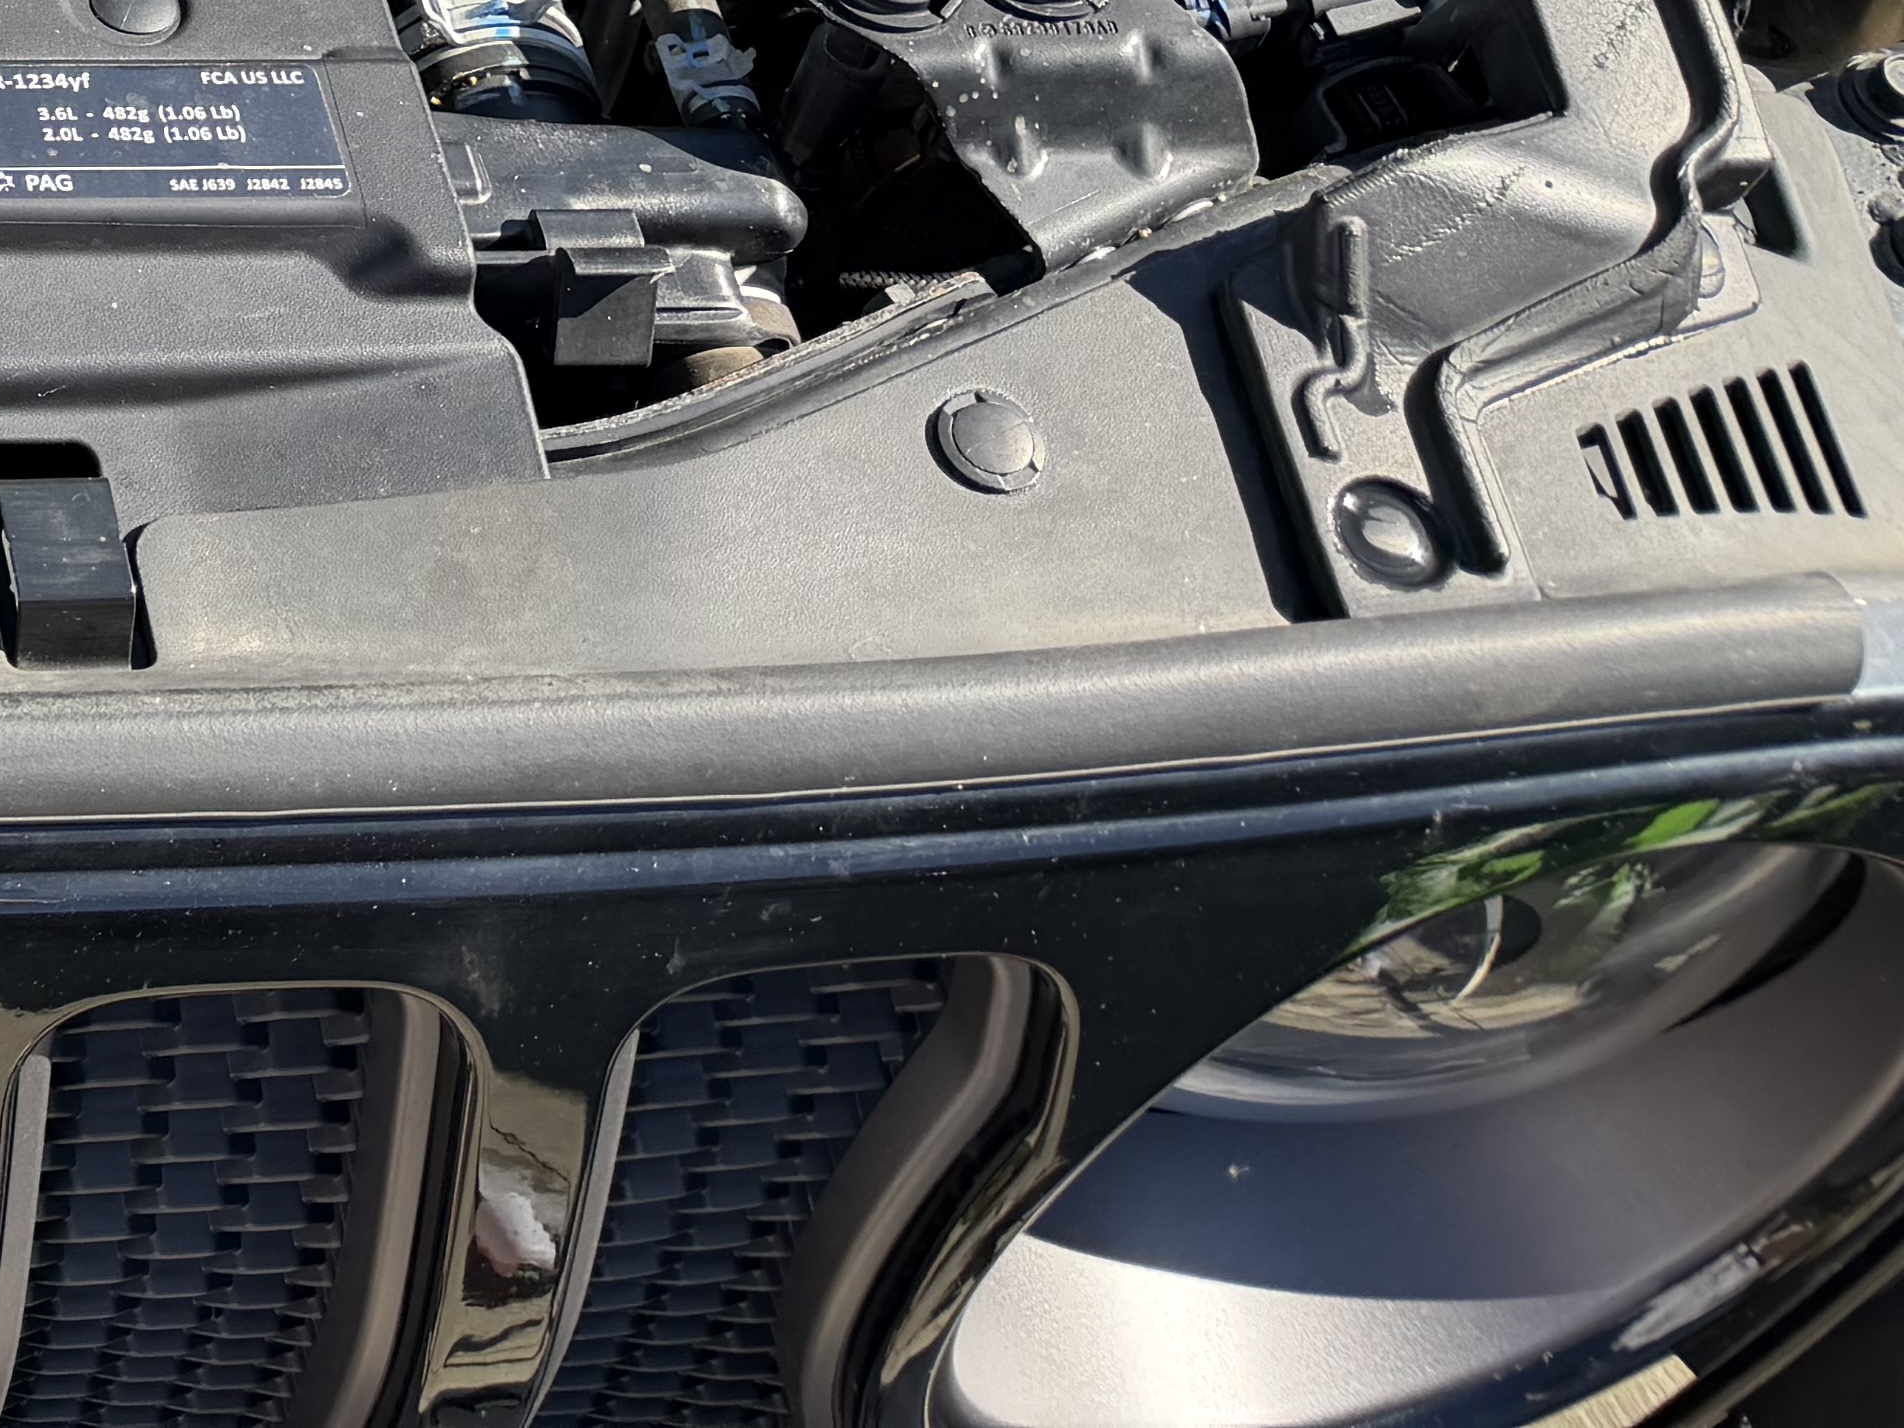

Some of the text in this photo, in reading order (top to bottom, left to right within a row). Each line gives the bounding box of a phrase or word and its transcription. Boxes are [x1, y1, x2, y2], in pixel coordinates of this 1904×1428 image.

[200, 69, 306, 86] FCA US LLC
[37, 107, 79, 122] 3.6L
[102, 106, 149, 123] 482g
[158, 105, 207, 123] (1.06
[210, 105, 242, 122] Lb)
[43, 127, 84, 143] 2.0L
[107, 126, 155, 144] 482g
[163, 126, 212, 144] (1.06
[215, 125, 248, 144] Lb)
[24, 174, 75, 193] PAG
[169, 177, 344, 192] SAE J639 J2842 J2845
